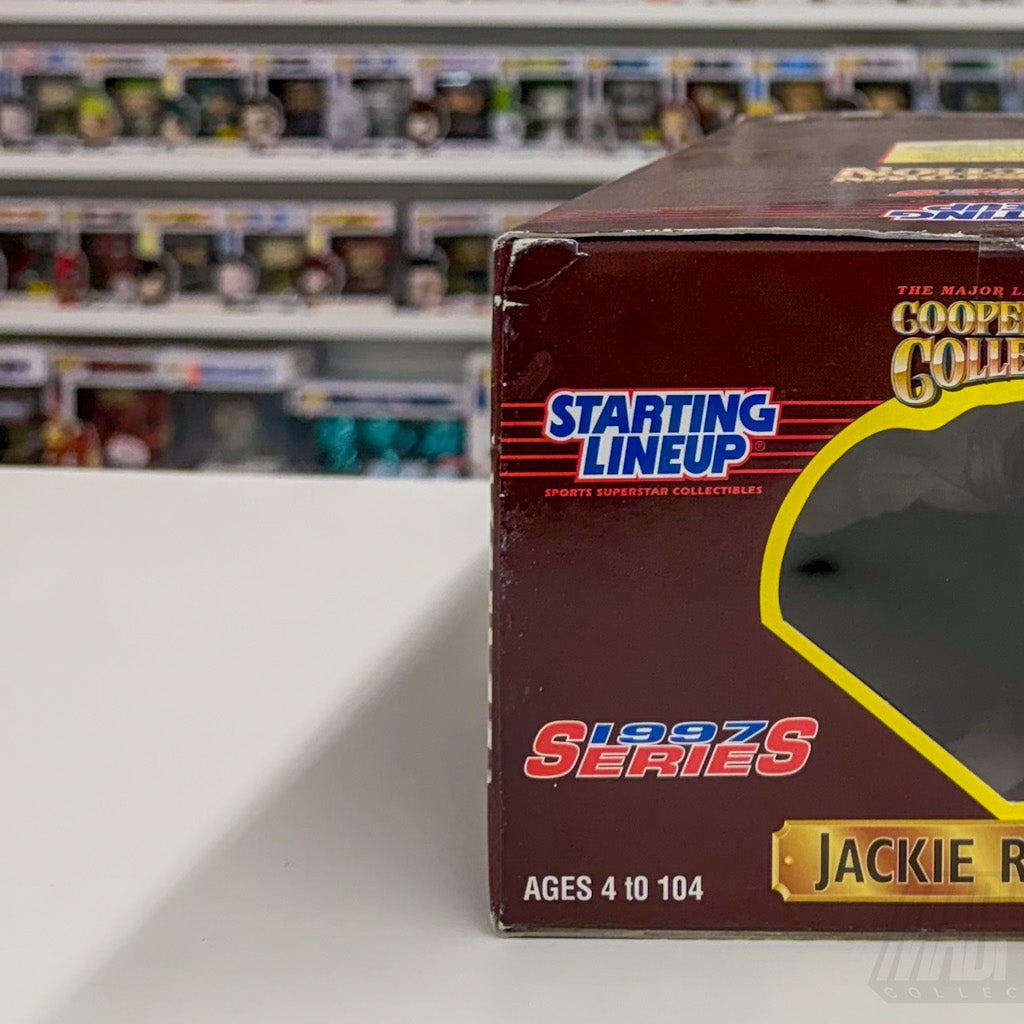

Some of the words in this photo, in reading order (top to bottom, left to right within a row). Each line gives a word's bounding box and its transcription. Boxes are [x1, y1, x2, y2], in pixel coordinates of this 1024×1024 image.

[898, 285, 934, 296] THE
[940, 286, 1004, 297] MAJOR
[547, 391, 779, 440] STARTING
[582, 433, 749, 476] LINEUP
[545, 488, 592, 497] SPORTS
[596, 487, 669, 497] SUPERSTAR
[672, 485, 763, 496] COLLECTIBLES
[523, 716, 820, 779] SERIES
[588, 720, 770, 745] 1997
[814, 831, 976, 892] JACKIE
[523, 875, 593, 901] AGES
[600, 875, 617, 901] 4
[657, 875, 704, 901] 104
